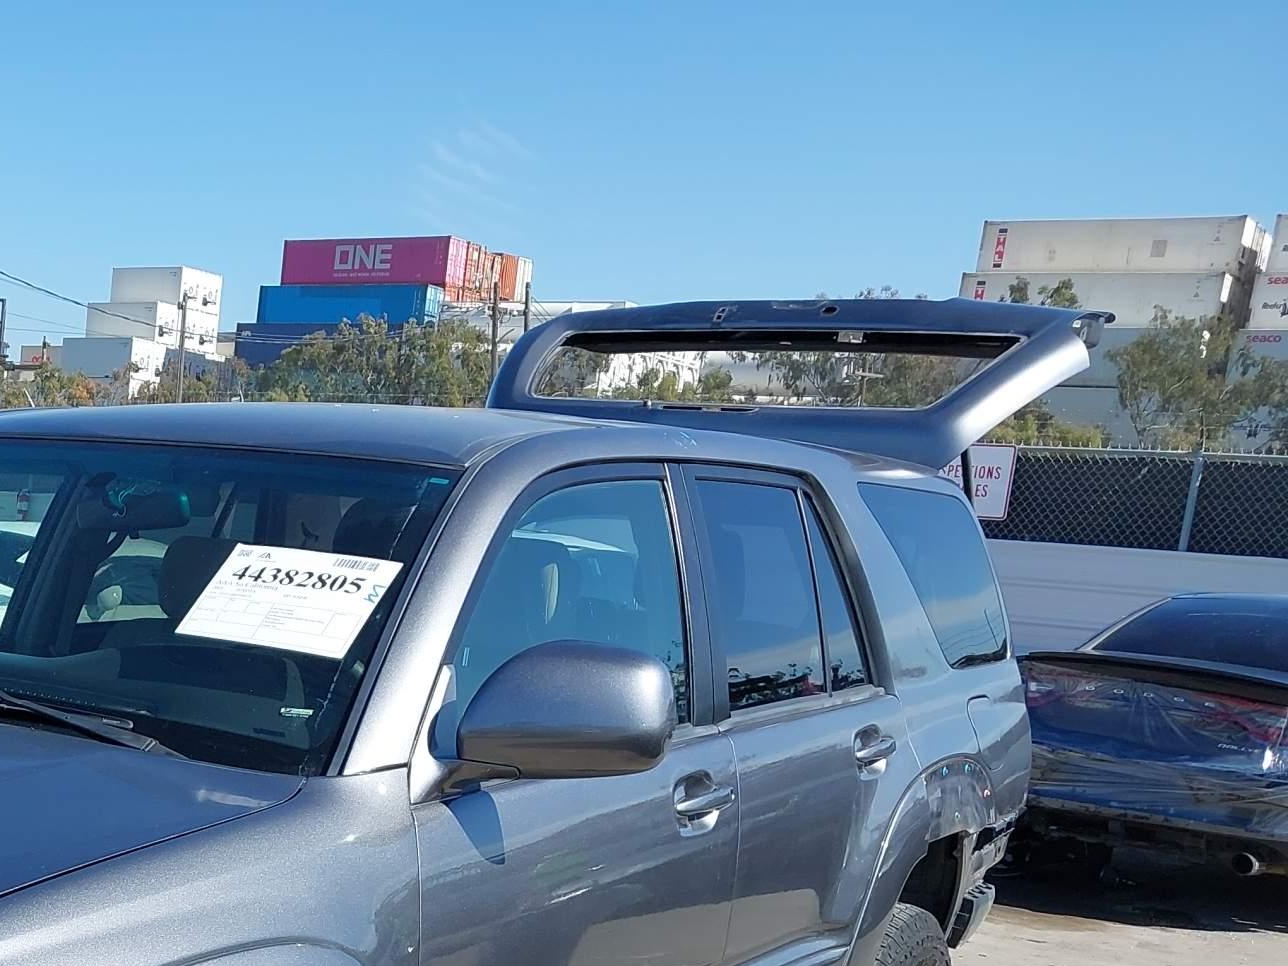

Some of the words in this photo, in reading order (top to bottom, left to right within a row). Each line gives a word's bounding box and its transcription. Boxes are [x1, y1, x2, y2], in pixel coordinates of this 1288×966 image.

[333, 244, 393, 270] ONE
[1267, 275, 1288, 285] sea
[1246, 334, 1282, 343] seaco
[232, 564, 367, 594] 44382805
